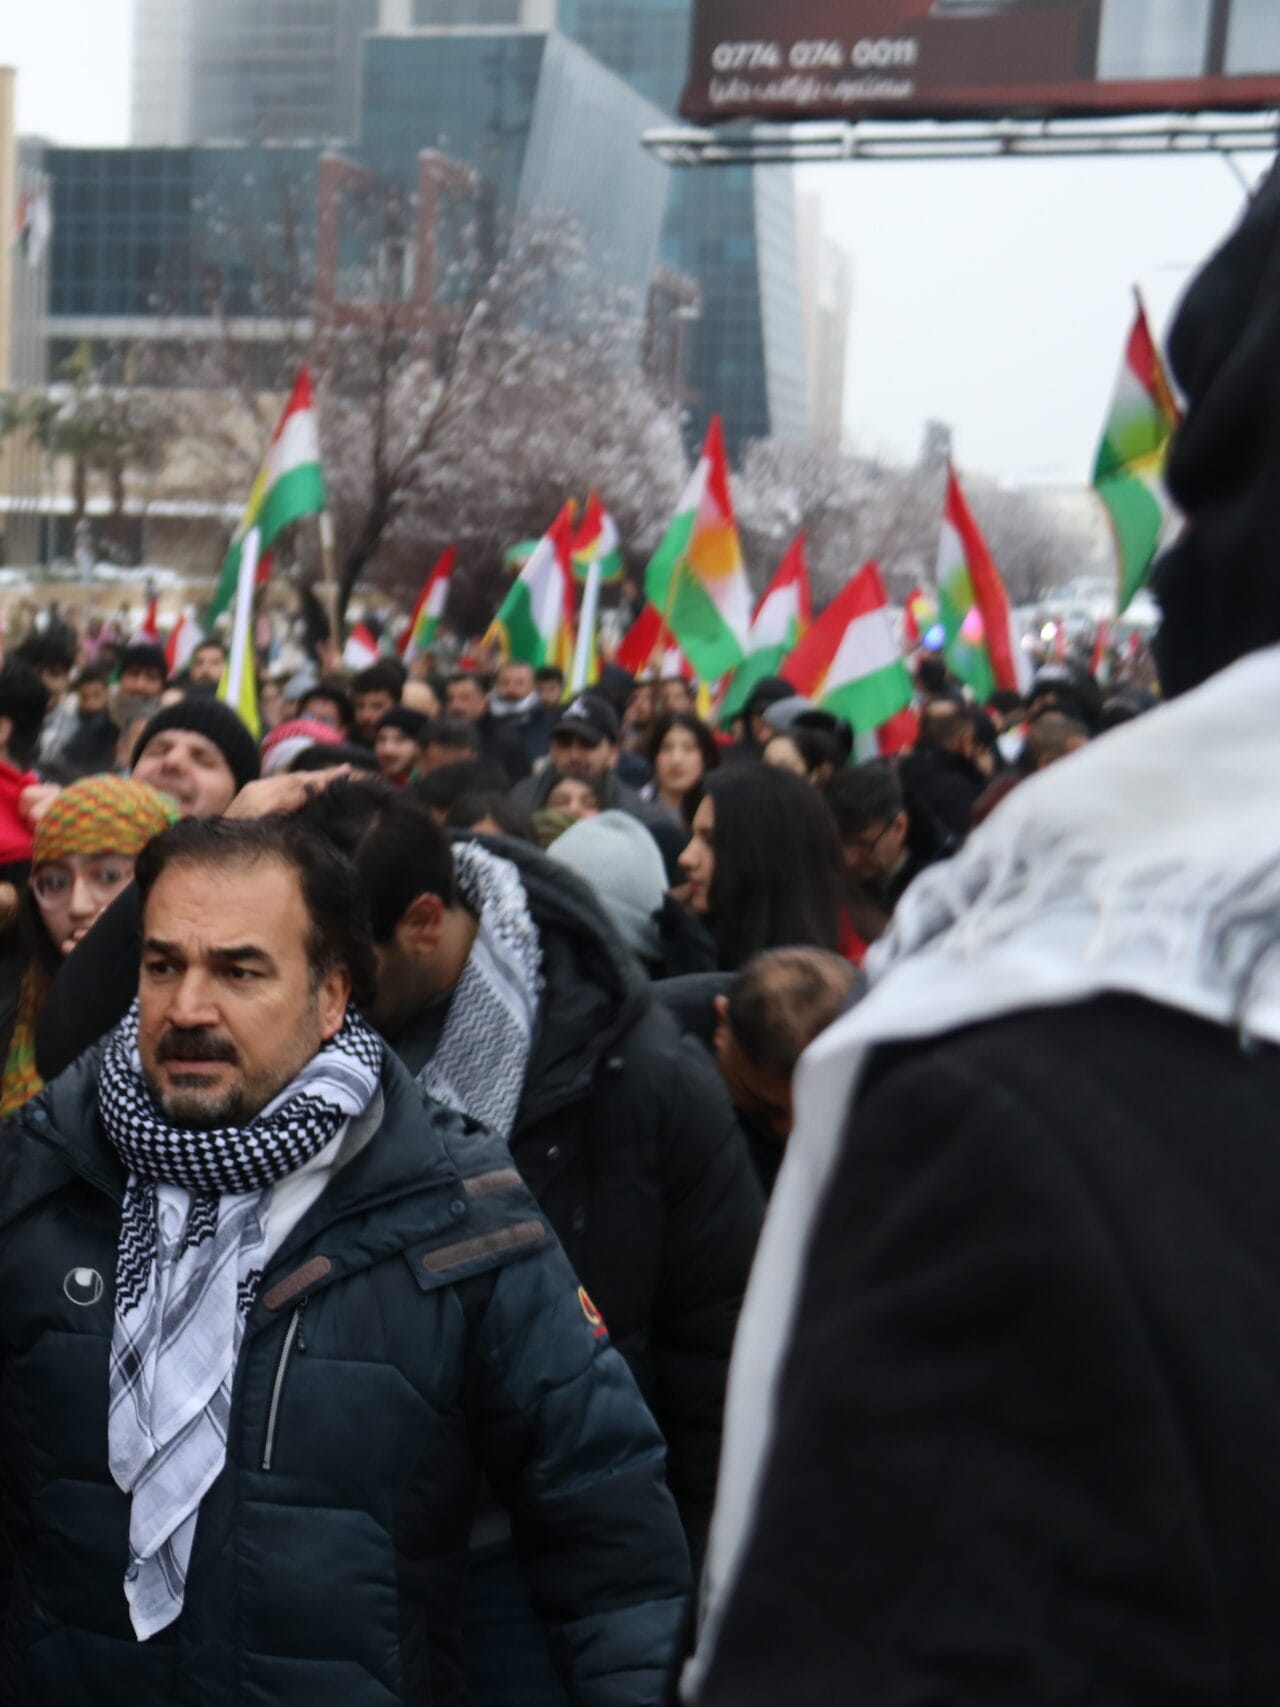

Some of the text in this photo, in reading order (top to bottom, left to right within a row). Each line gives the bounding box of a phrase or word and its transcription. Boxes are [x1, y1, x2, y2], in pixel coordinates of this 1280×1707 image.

[712, 38, 917, 71] 0774 074 0011
